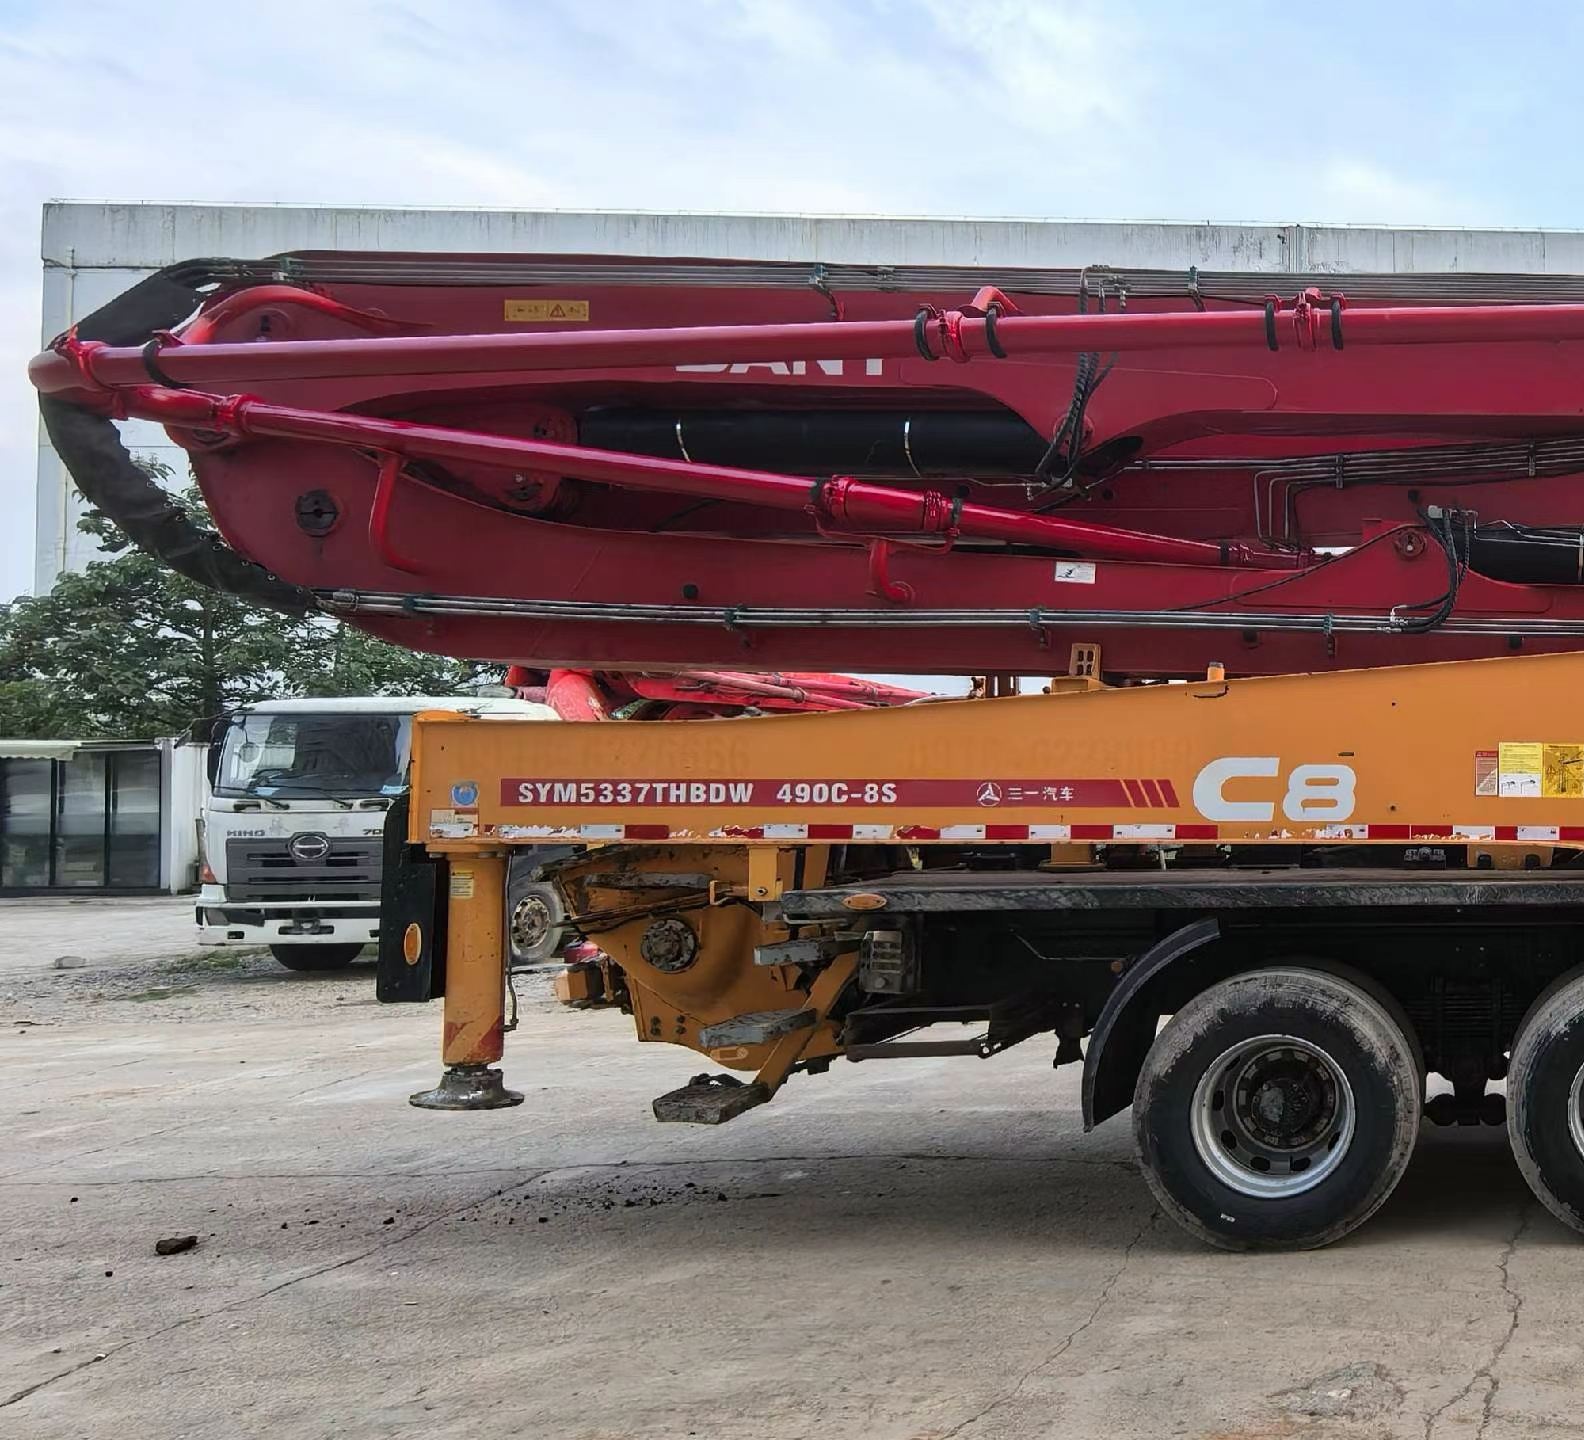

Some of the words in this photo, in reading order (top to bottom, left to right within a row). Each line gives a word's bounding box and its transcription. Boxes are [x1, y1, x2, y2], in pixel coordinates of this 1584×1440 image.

[519, 783, 753, 803] SYM5337THBDW
[776, 784, 897, 803] 490C-8S
[1008, 787, 1074, 801] 三一汽车
[1193, 757, 1357, 821] C8
